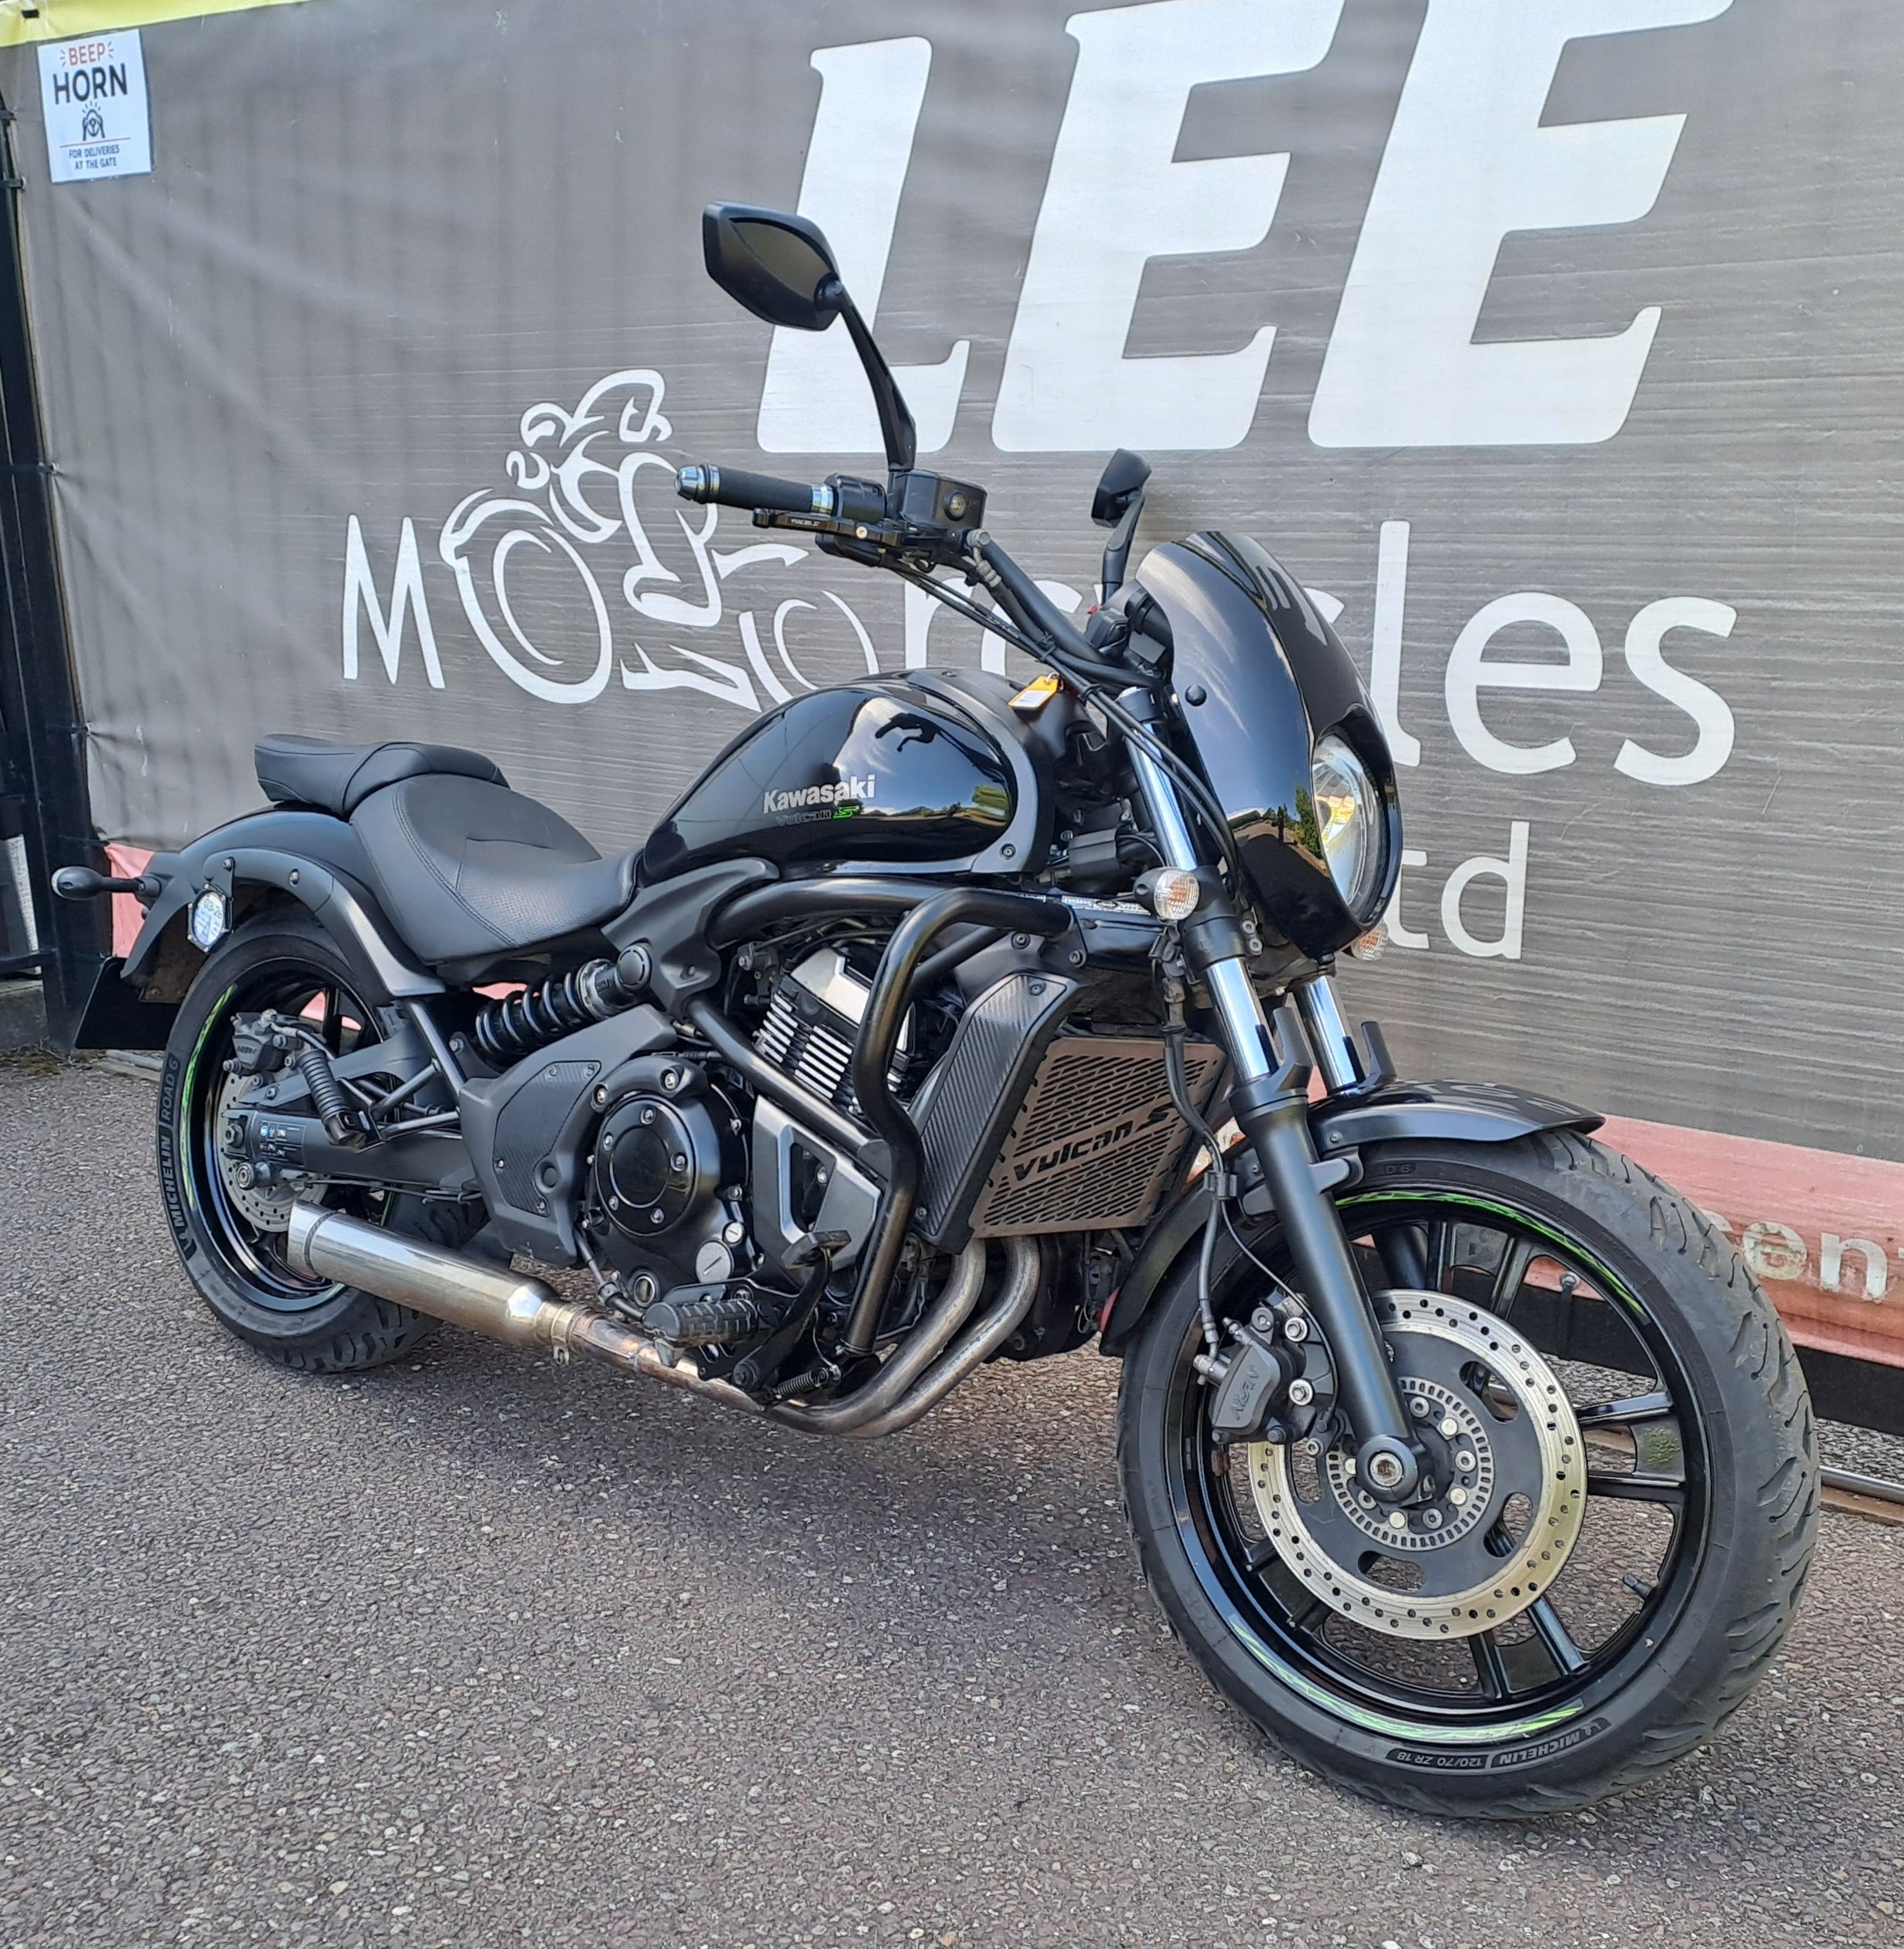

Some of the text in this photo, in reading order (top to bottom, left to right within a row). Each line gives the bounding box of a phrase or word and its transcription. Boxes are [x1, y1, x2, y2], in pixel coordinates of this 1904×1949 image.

[69, 43, 106, 66] BEEP
[52, 62, 128, 105] HORN
[69, 144, 119, 159] FOR DELIVERIES
[75, 157, 117, 170] AT THE GATE
[757, 0, 1735, 452] LEE
[763, 774, 876, 814] Kawasaki
[833, 805, 860, 820] S
[161, 1073, 175, 1120] ROAD
[160, 1135, 185, 1227] MICHELIN
[1396, 1730, 1581, 1767] MICHELIN 120/70 ZR 18
